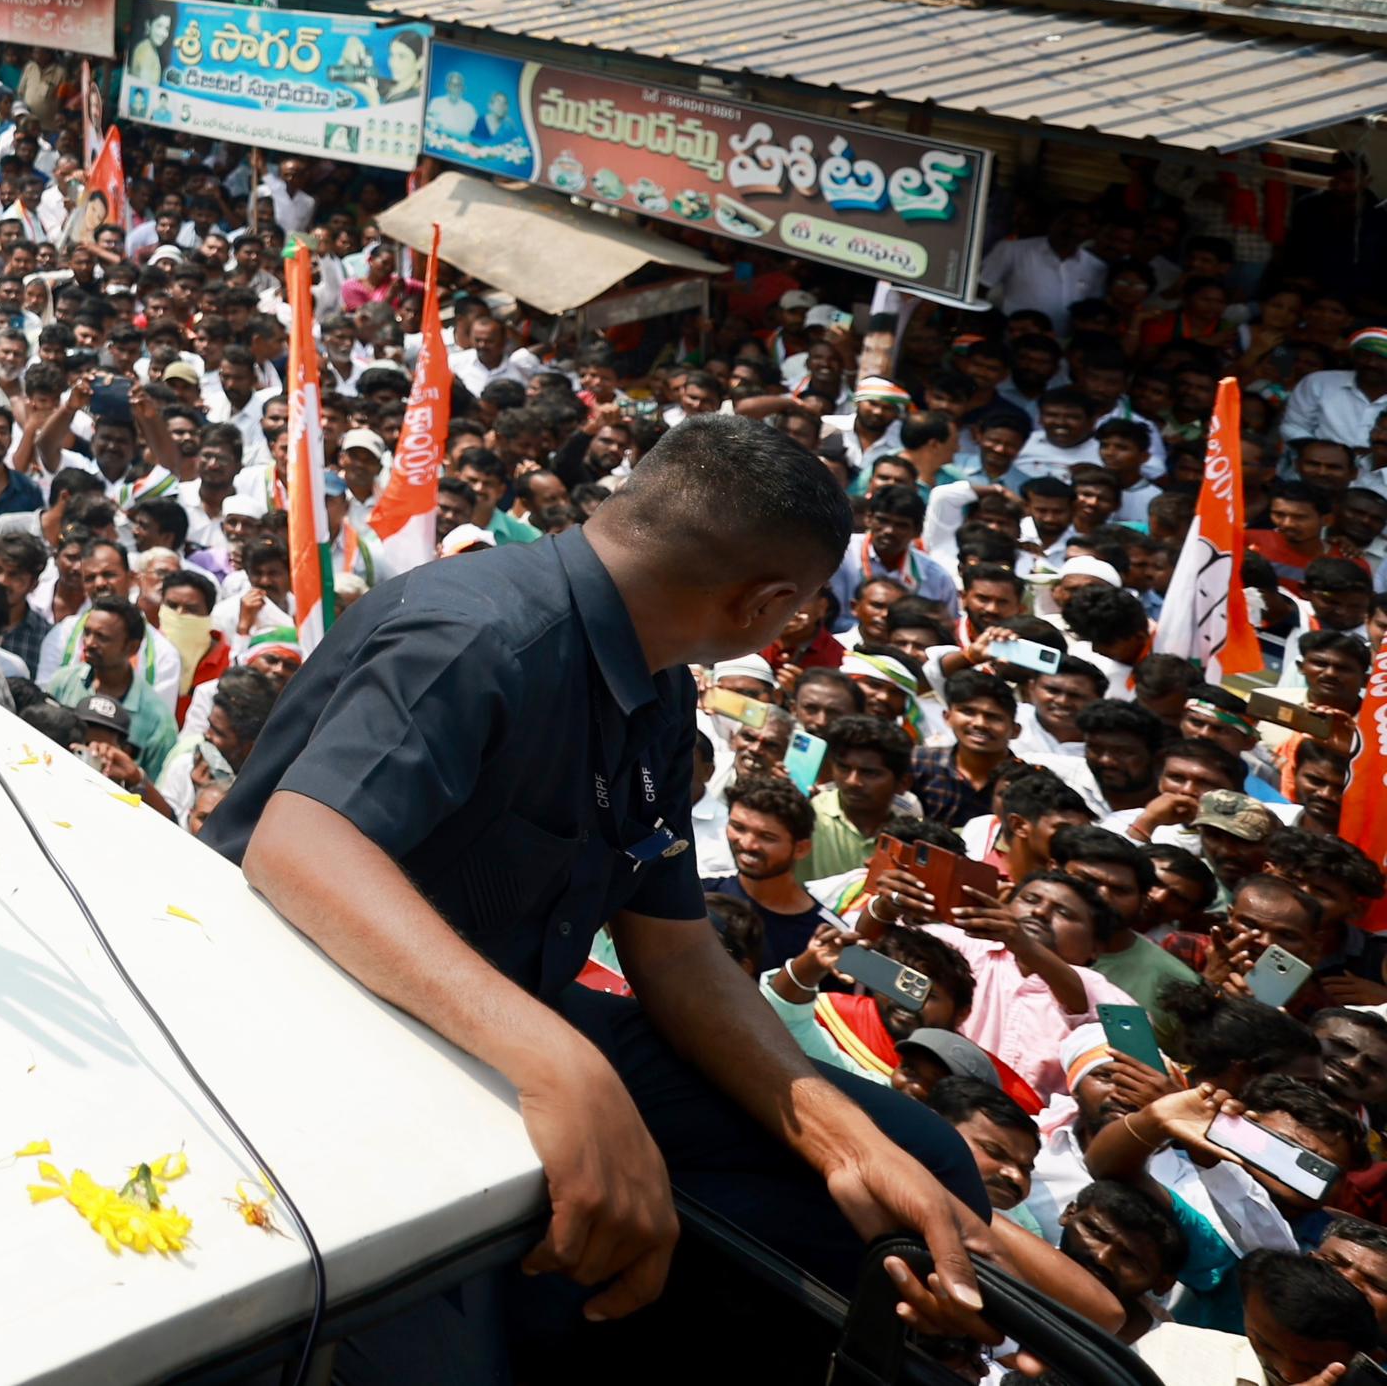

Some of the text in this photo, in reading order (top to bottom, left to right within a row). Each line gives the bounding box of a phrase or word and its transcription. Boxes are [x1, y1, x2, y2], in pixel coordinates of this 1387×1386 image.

[173, 18, 323, 74] శ్రీ సాగర్
[538, 88, 971, 221] ముకుందమ్మ హోటల్
[594, 772, 610, 808] CRPF
[642, 766, 656, 802] CRPF
